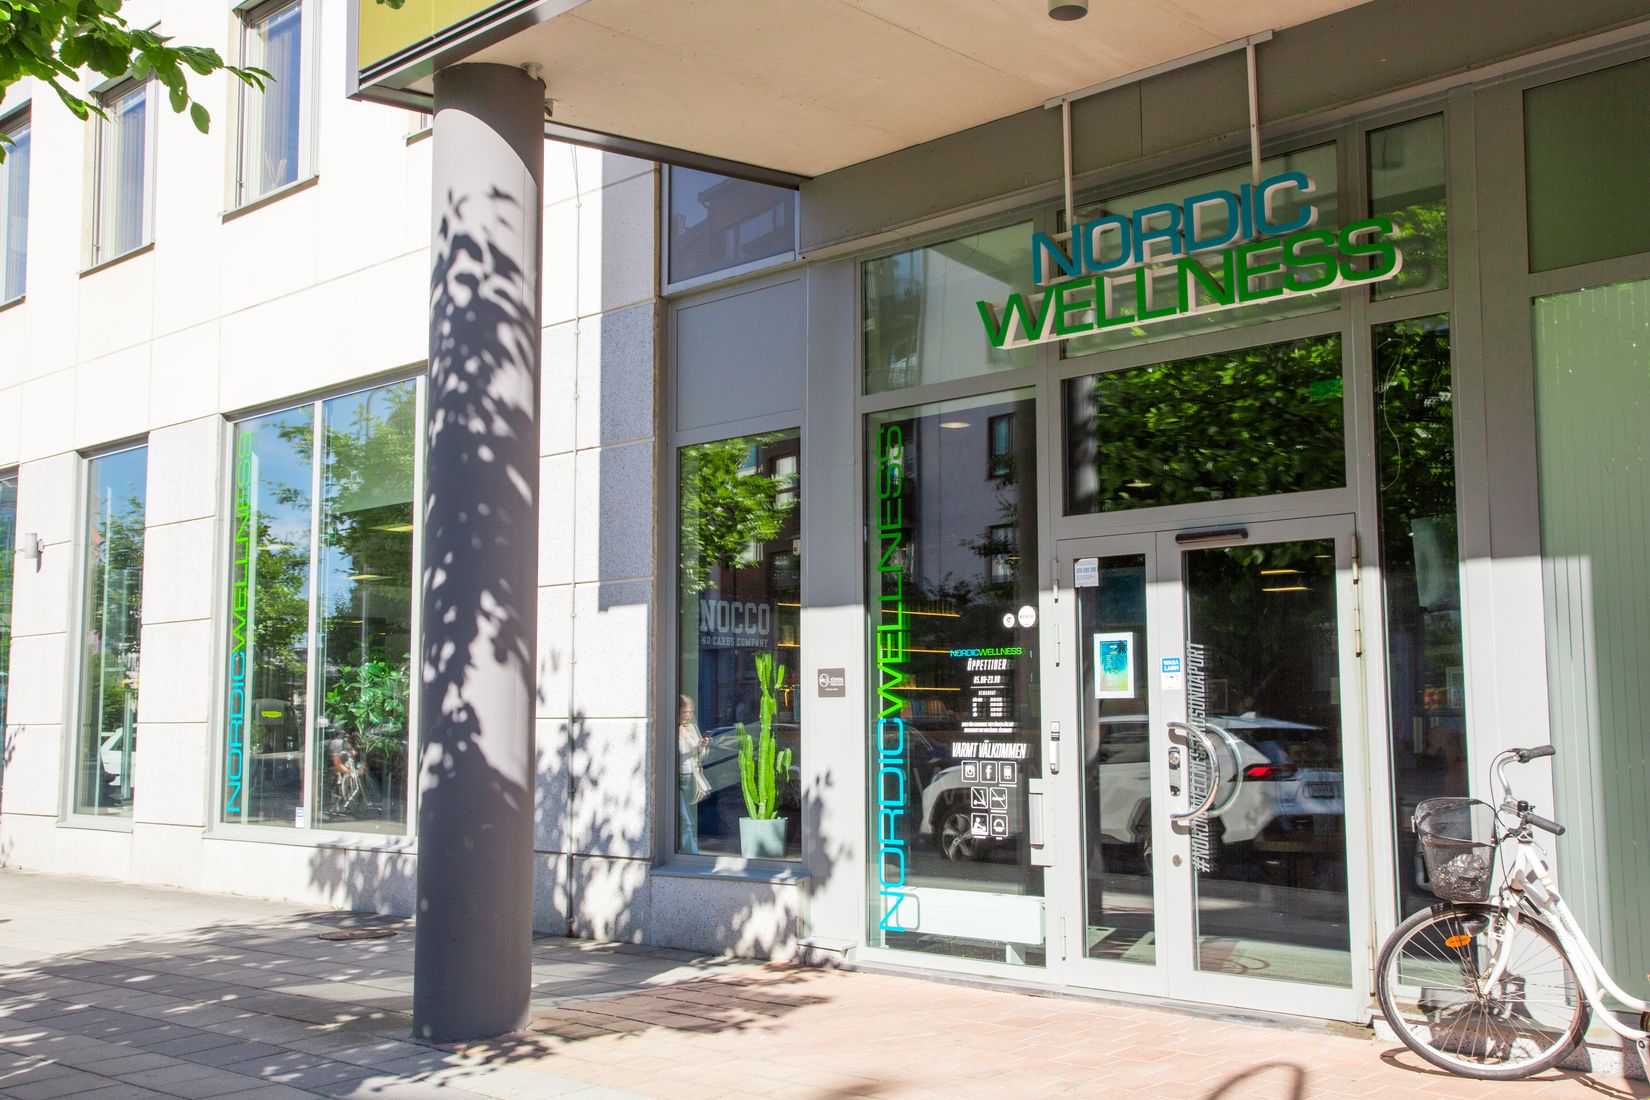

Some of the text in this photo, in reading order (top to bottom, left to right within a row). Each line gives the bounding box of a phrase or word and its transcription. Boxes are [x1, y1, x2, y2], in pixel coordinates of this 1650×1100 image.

[1032, 171, 1316, 285] NORDIC
[976, 216, 1400, 348] WELLNESS
[700, 599, 770, 635] NOCCO
[701, 635, 769, 648] NO CARBS COMPANY
[952, 740, 1027, 758] VARMT VÄLKOMMEN
